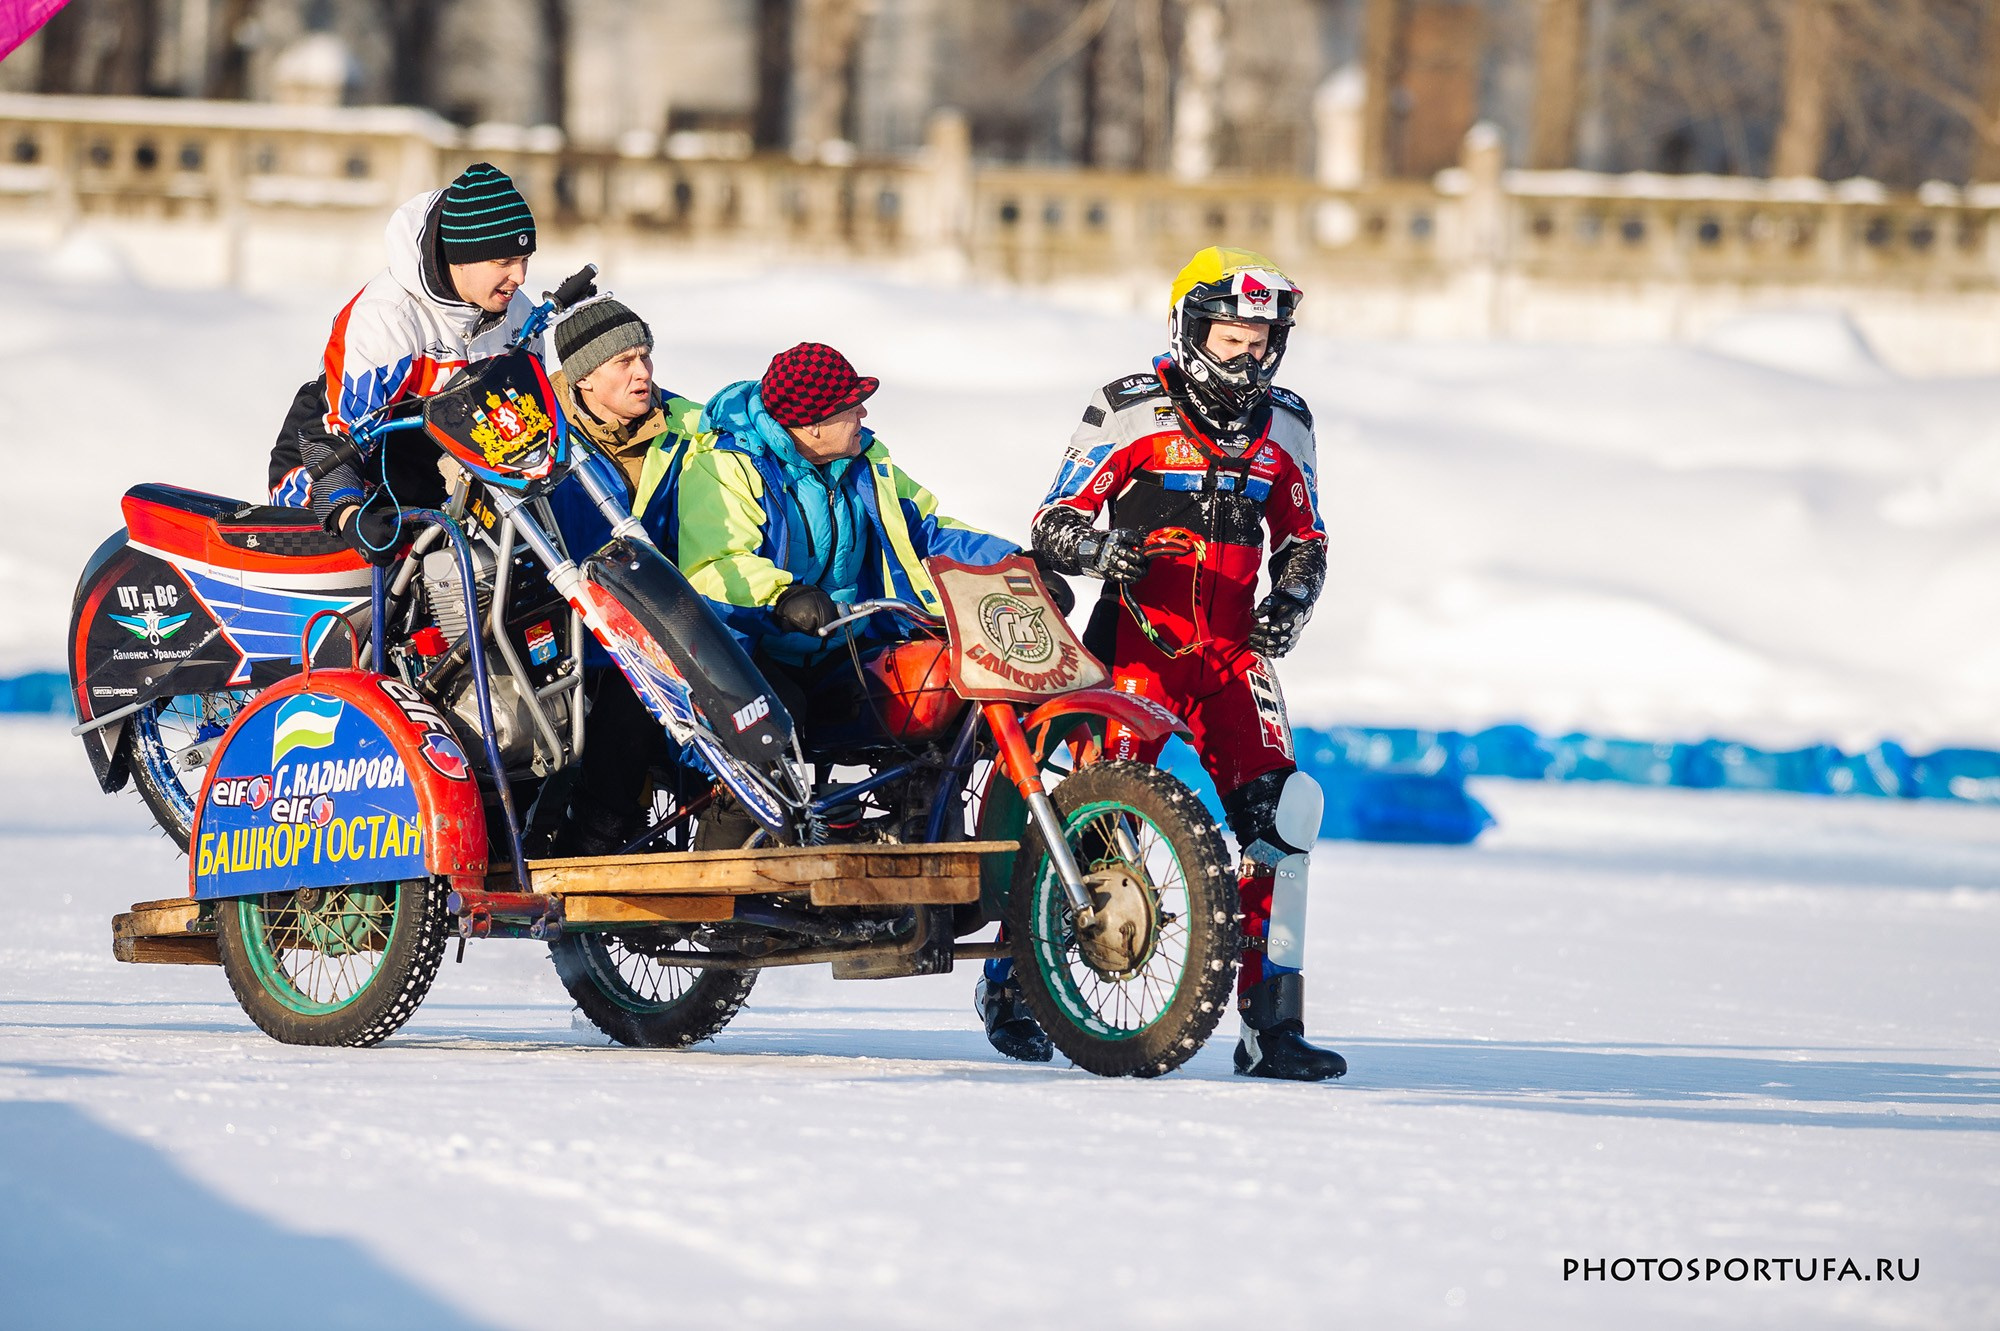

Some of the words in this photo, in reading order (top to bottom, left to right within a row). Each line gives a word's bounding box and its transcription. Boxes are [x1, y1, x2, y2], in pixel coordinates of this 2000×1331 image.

[117, 585, 140, 611] ЦТ
[154, 584, 179, 608] ВС
[112, 648, 149, 661] Каменск
[380, 680, 452, 735] elf
[732, 694, 770, 732] 106
[212, 780, 248, 806] elf
[271, 797, 312, 824] elf
[197, 812, 424, 877] БАШКОРТОСТАН
